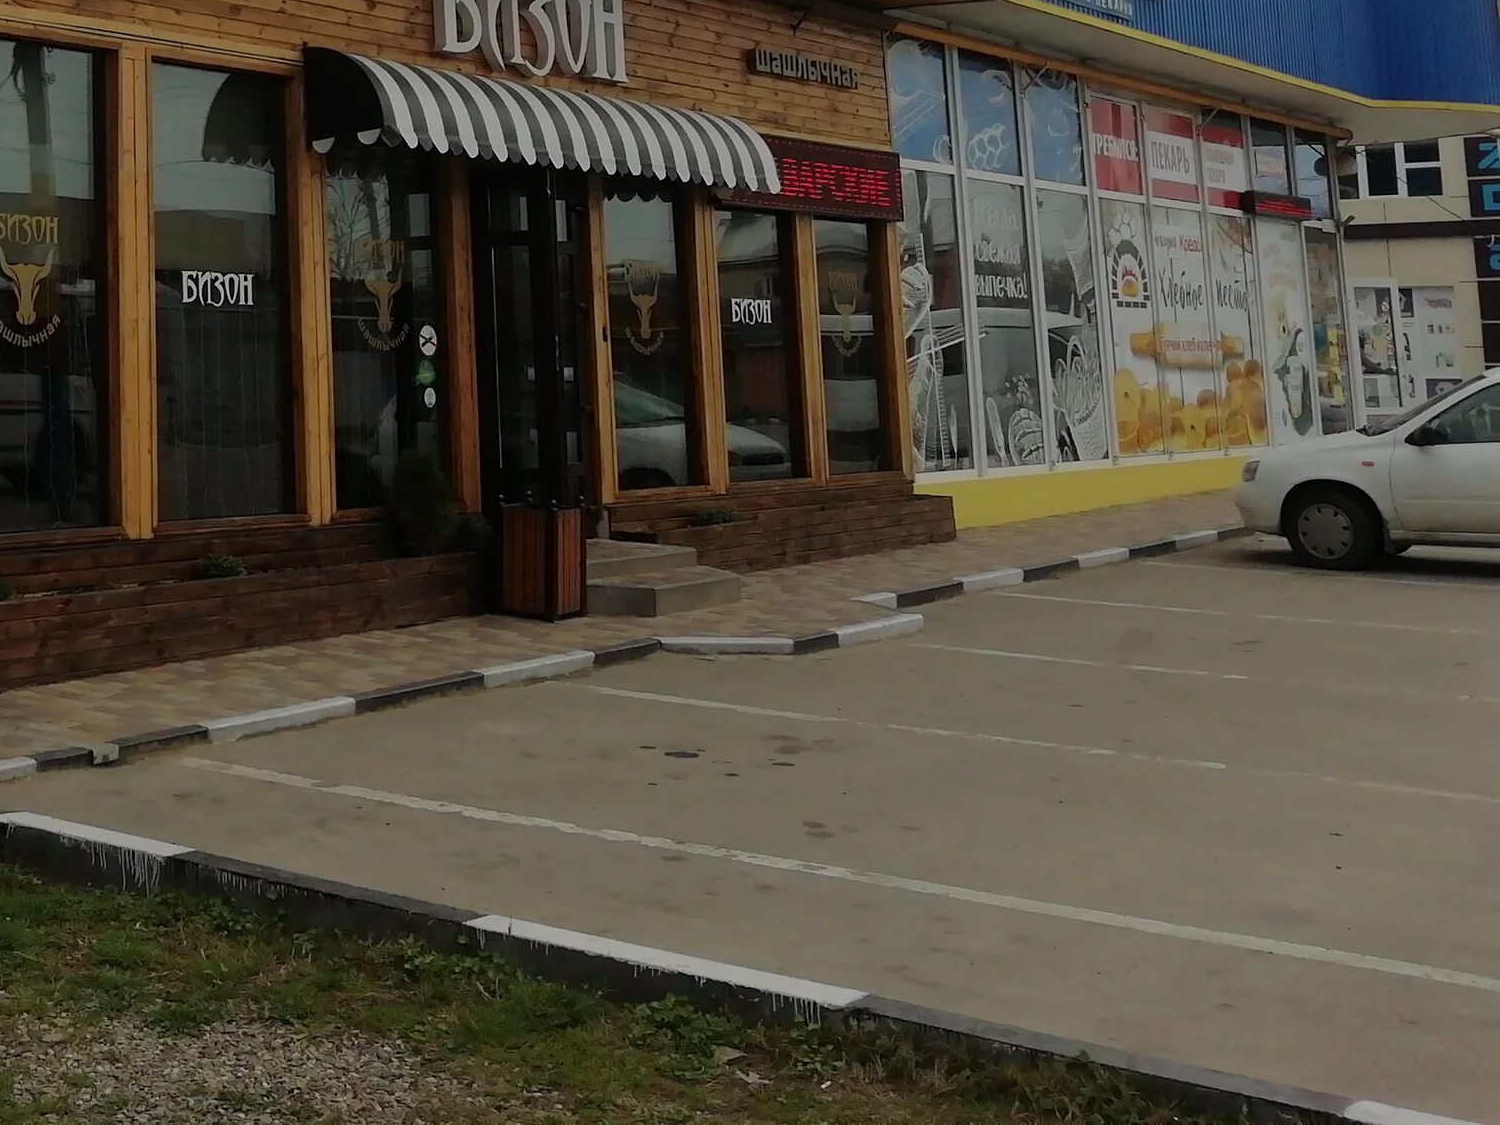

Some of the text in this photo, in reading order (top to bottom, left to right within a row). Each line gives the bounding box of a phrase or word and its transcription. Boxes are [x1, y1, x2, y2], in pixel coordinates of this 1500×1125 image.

[754, 47, 862, 89] шашлычная
[1151, 140, 1190, 173] ПЕКАРЬ
[181, 270, 255, 307] БИЗОН
[975, 273, 1028, 299] выпечка!
[731, 298, 772, 325] БИЗОН
